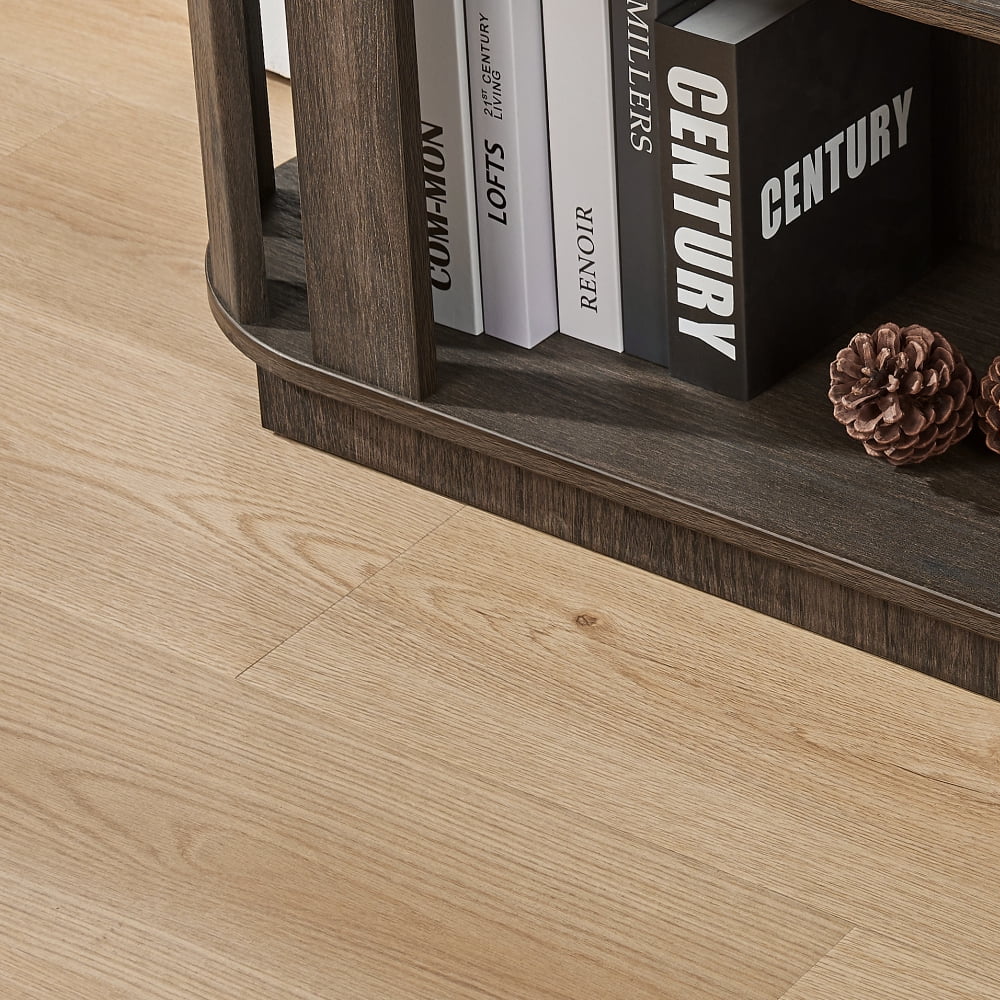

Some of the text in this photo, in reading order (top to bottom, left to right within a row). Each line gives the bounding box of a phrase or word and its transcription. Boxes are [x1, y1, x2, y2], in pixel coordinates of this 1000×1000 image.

[479, 11, 492, 85] CENTURY
[492, 70, 503, 121] LIVING
[484, 138, 508, 226] LOFTS
[760, 87, 914, 240] CENTURY
[575, 205, 599, 314] RENOIR
[666, 65, 737, 361] CENTURY
